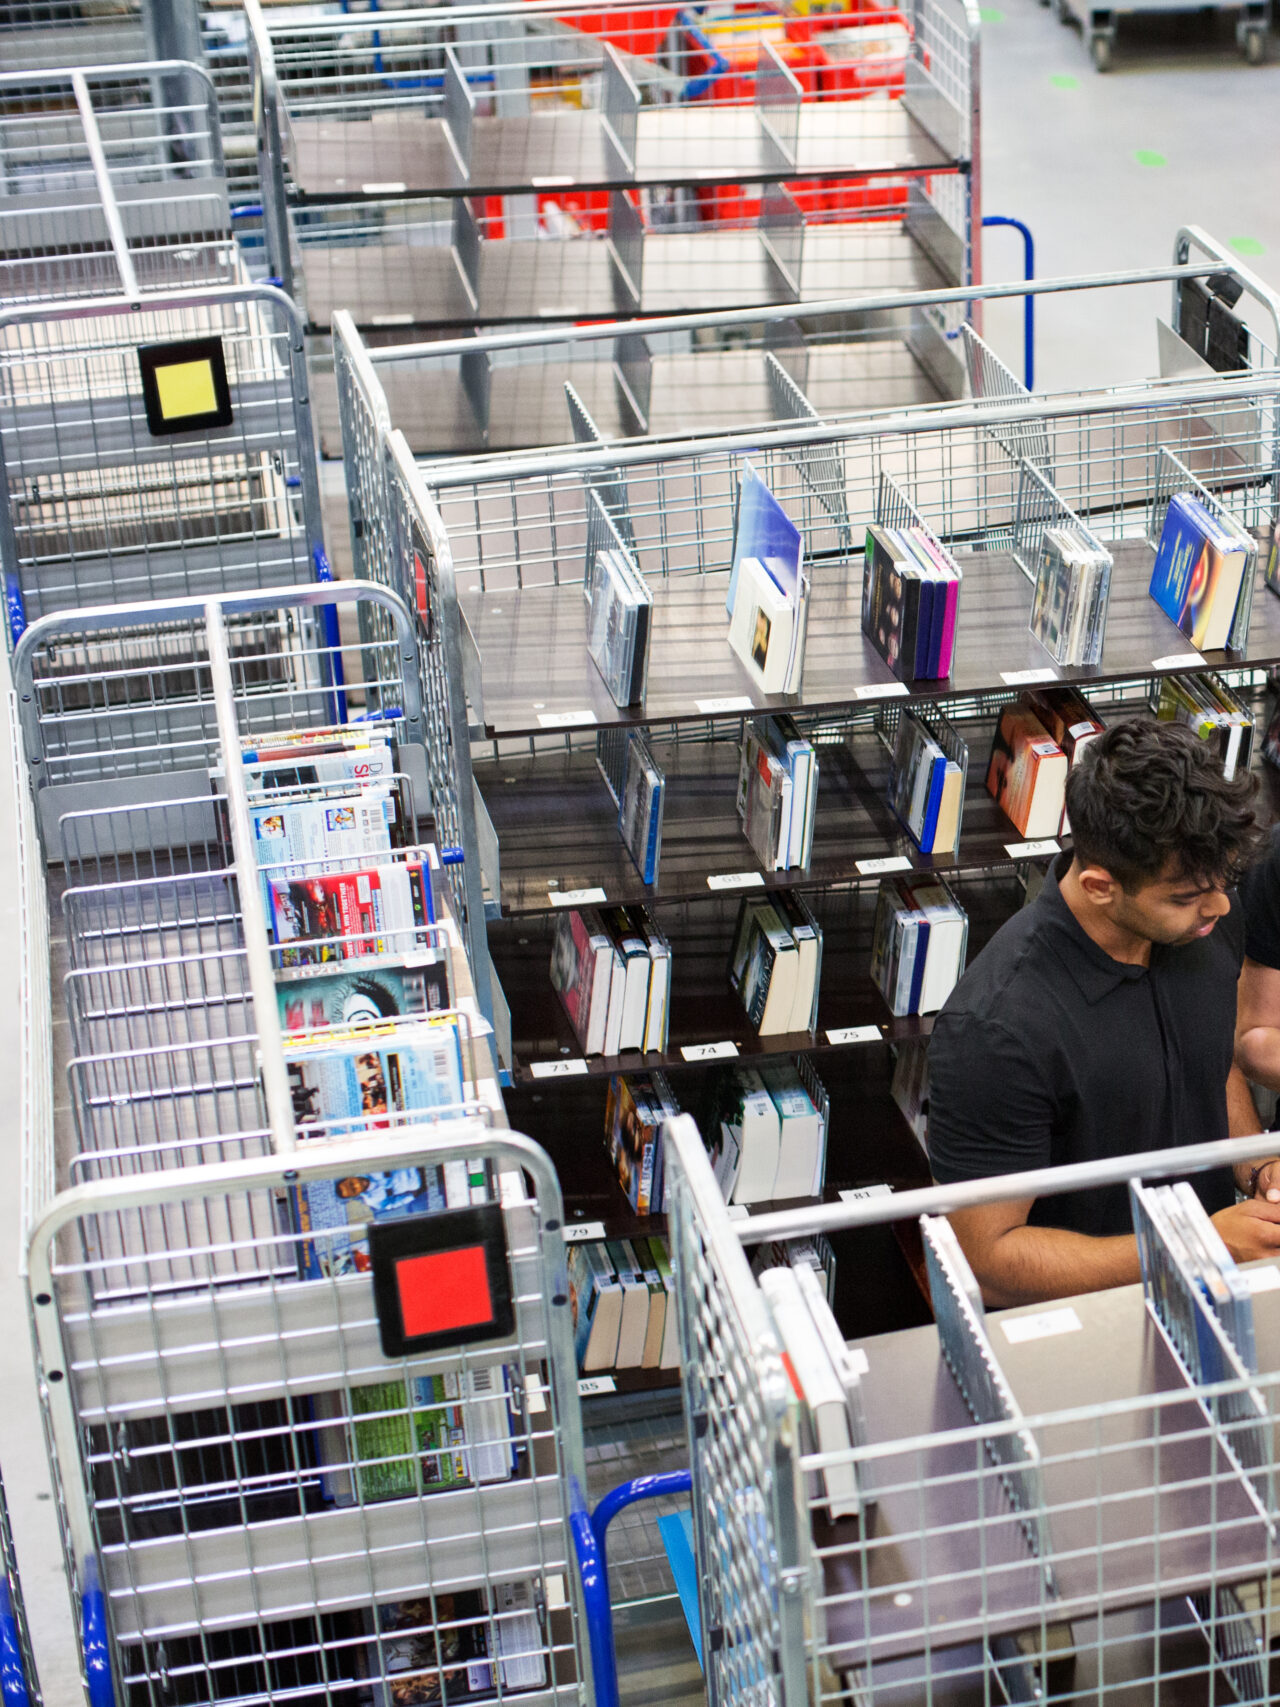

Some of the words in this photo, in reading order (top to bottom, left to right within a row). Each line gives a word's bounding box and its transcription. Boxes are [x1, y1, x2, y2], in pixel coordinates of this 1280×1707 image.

[839, 1031, 859, 1040] 75
[698, 1046, 717, 1056] 74
[551, 1063, 570, 1073] 73
[852, 1190, 871, 1200] 81
[568, 1227, 588, 1238] 79
[580, 1381, 600, 1392] 85
